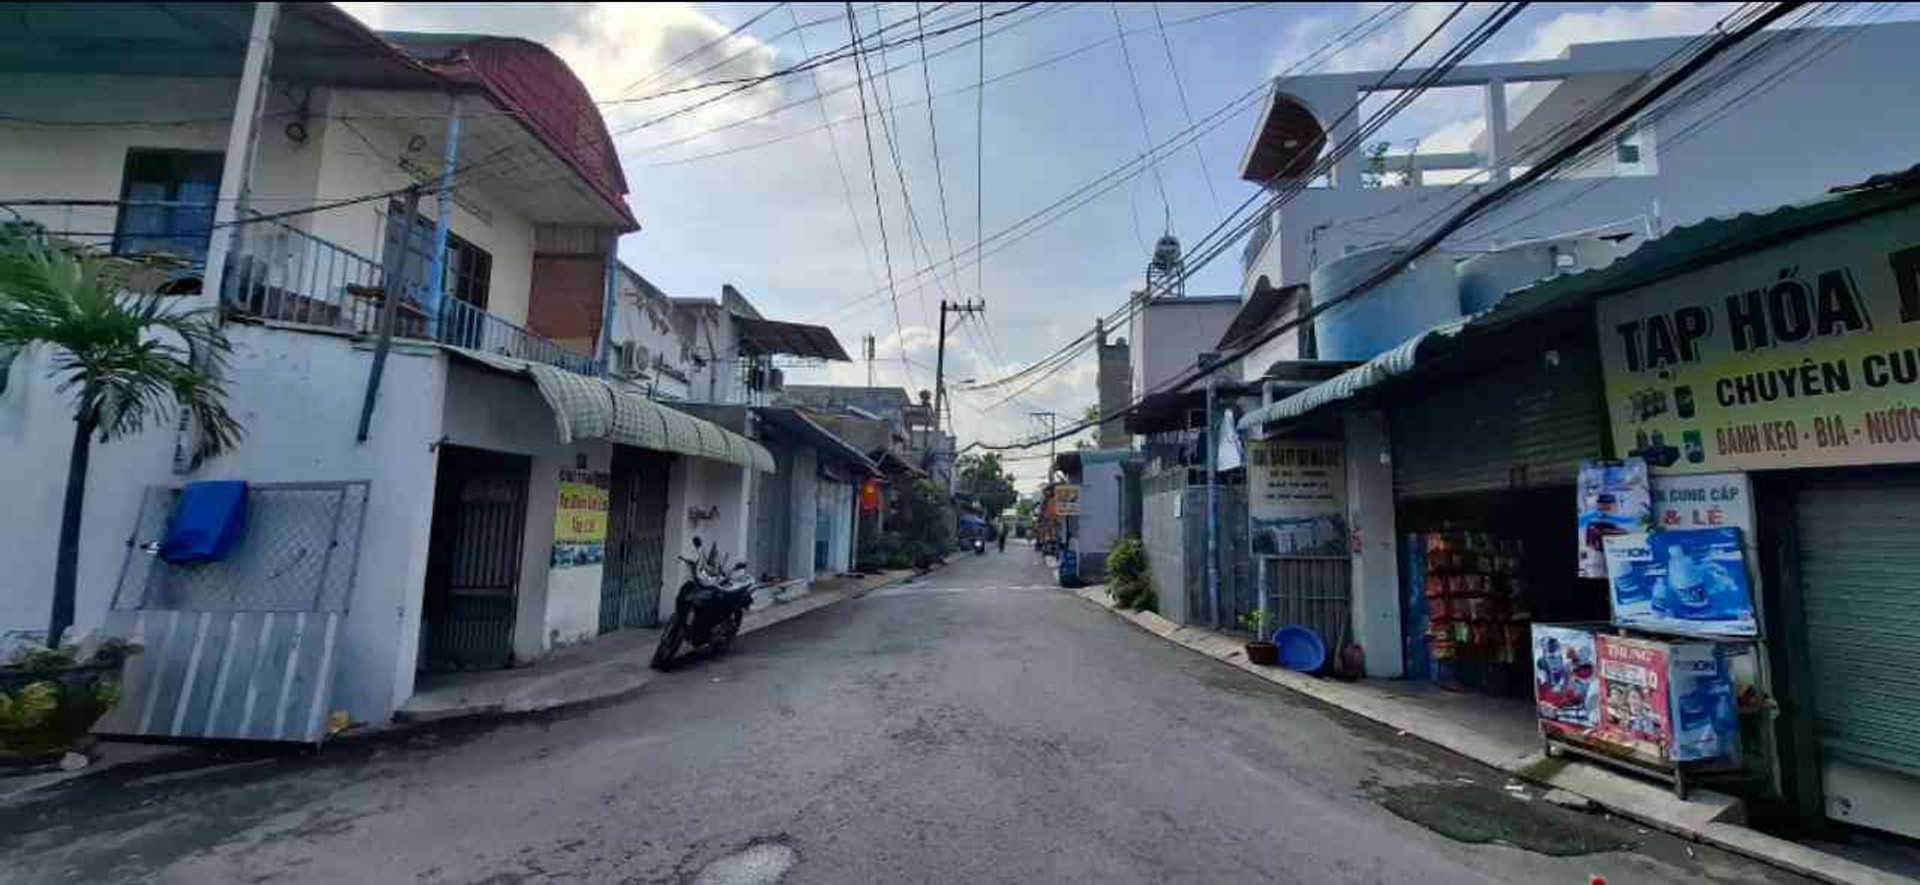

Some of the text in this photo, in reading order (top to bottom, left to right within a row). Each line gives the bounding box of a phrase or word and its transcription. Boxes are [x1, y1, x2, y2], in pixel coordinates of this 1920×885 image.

[1616, 306, 1712, 379] TẠP
[1725, 265, 1873, 352] HÓA
[1716, 347, 1920, 407] CHUYÊN CU
[1716, 421, 1761, 456] BÁNH
[1765, 419, 1799, 457] KẸO
[1813, 413, 1850, 449] BIA
[1670, 488, 1706, 502] CUNG
[1710, 485, 1740, 502] CẤP
